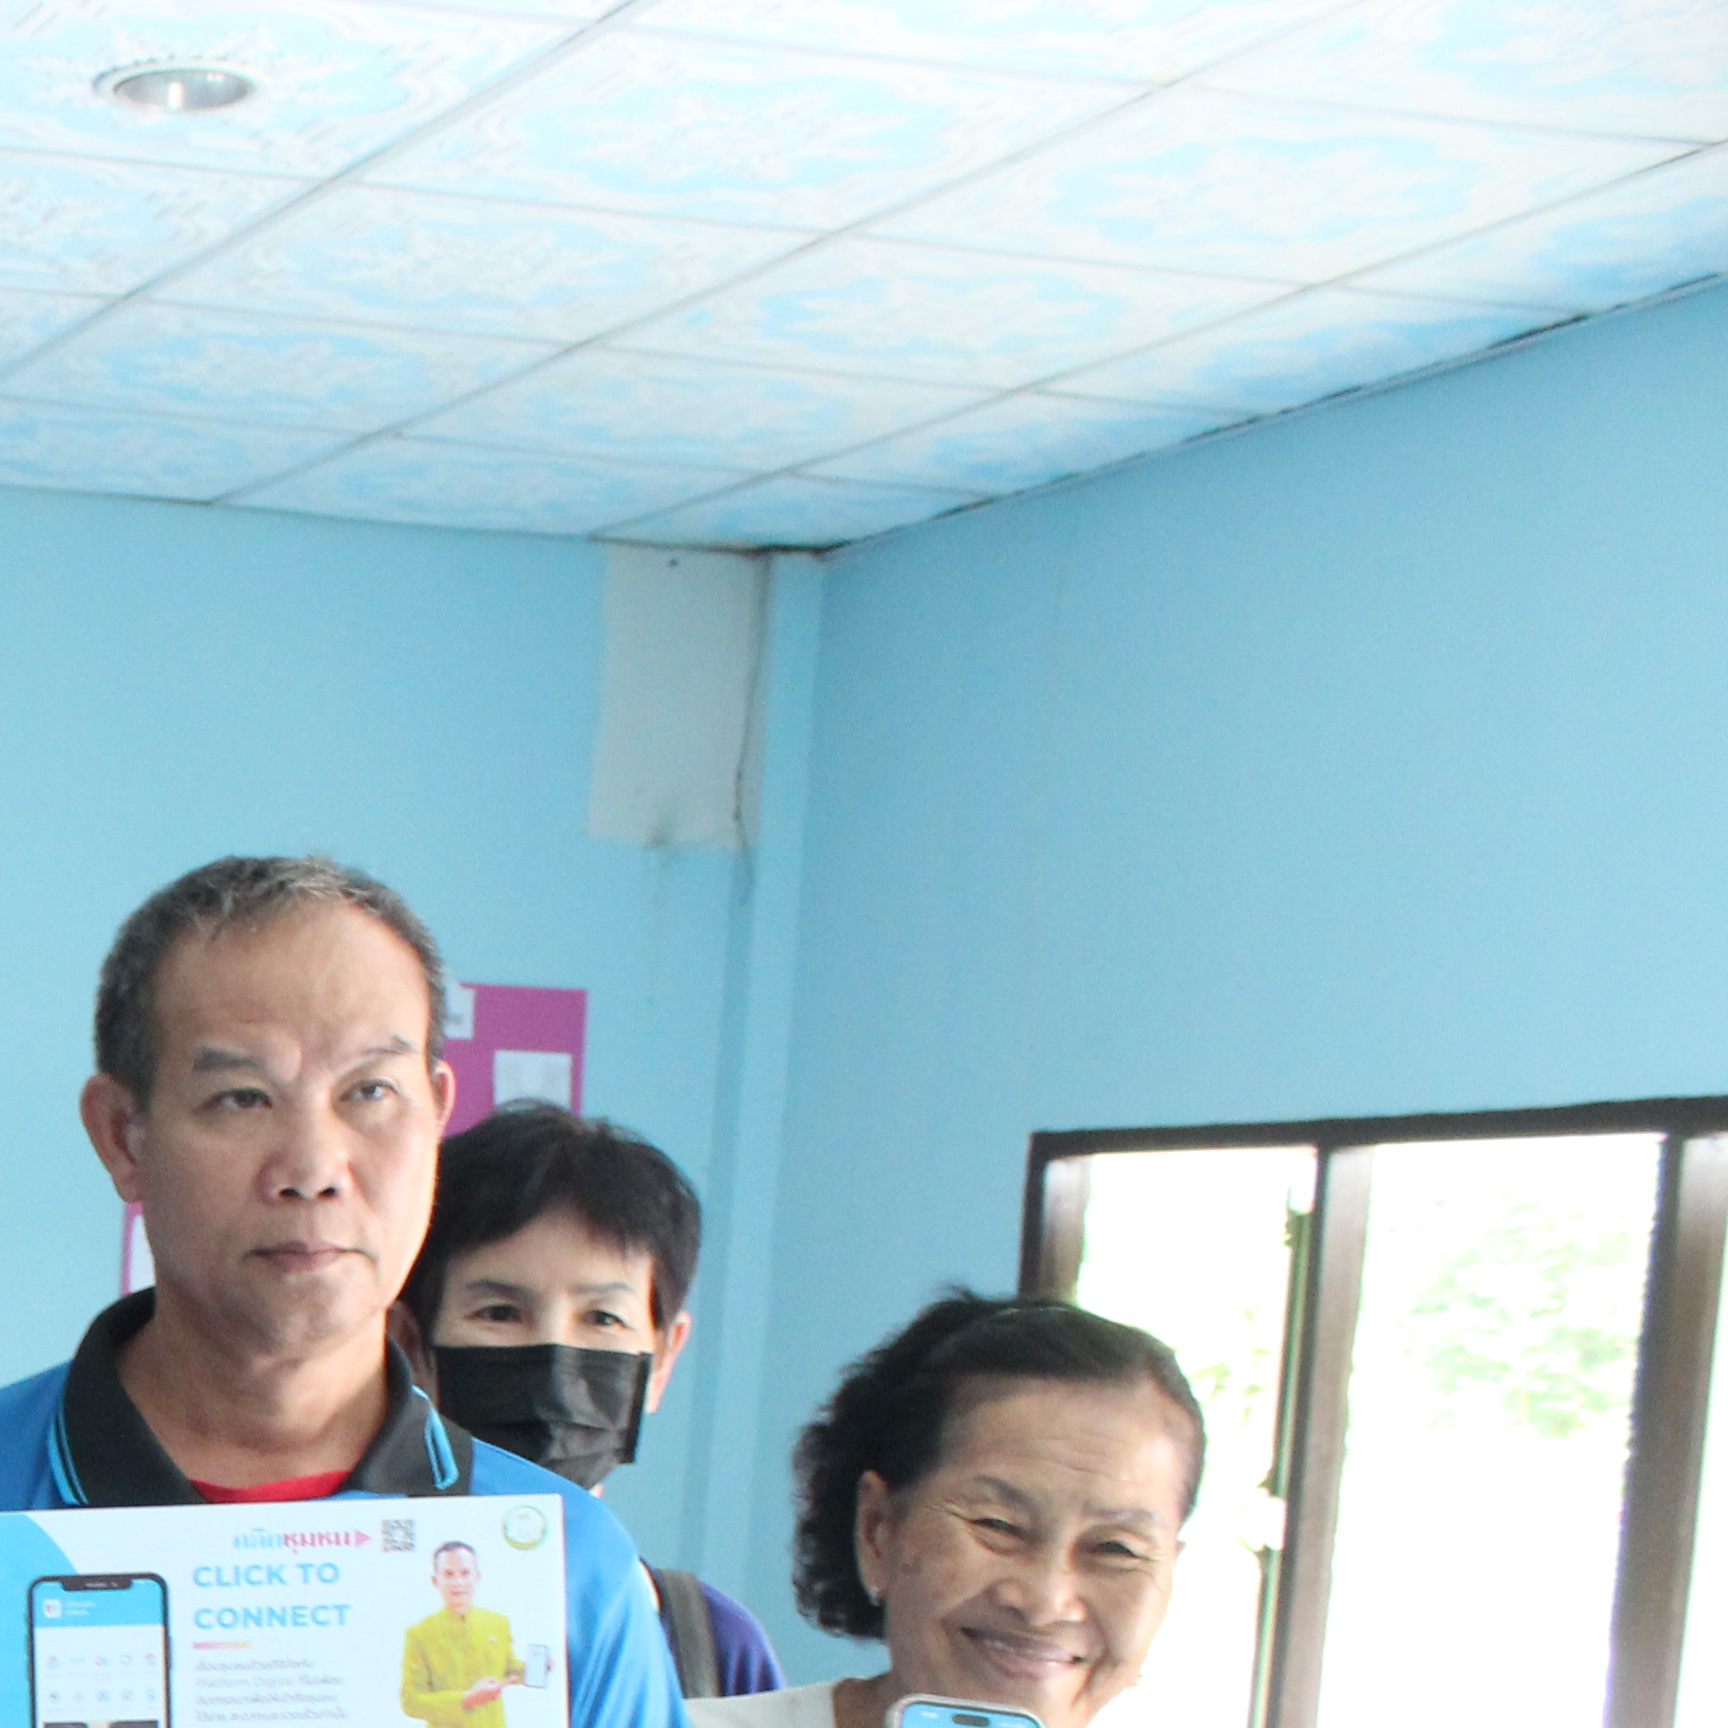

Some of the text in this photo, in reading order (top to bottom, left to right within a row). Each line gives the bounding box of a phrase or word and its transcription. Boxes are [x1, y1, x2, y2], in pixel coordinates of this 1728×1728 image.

[193, 1561, 341, 1588] CLICK TO
[193, 1603, 351, 1631] CONNECT
